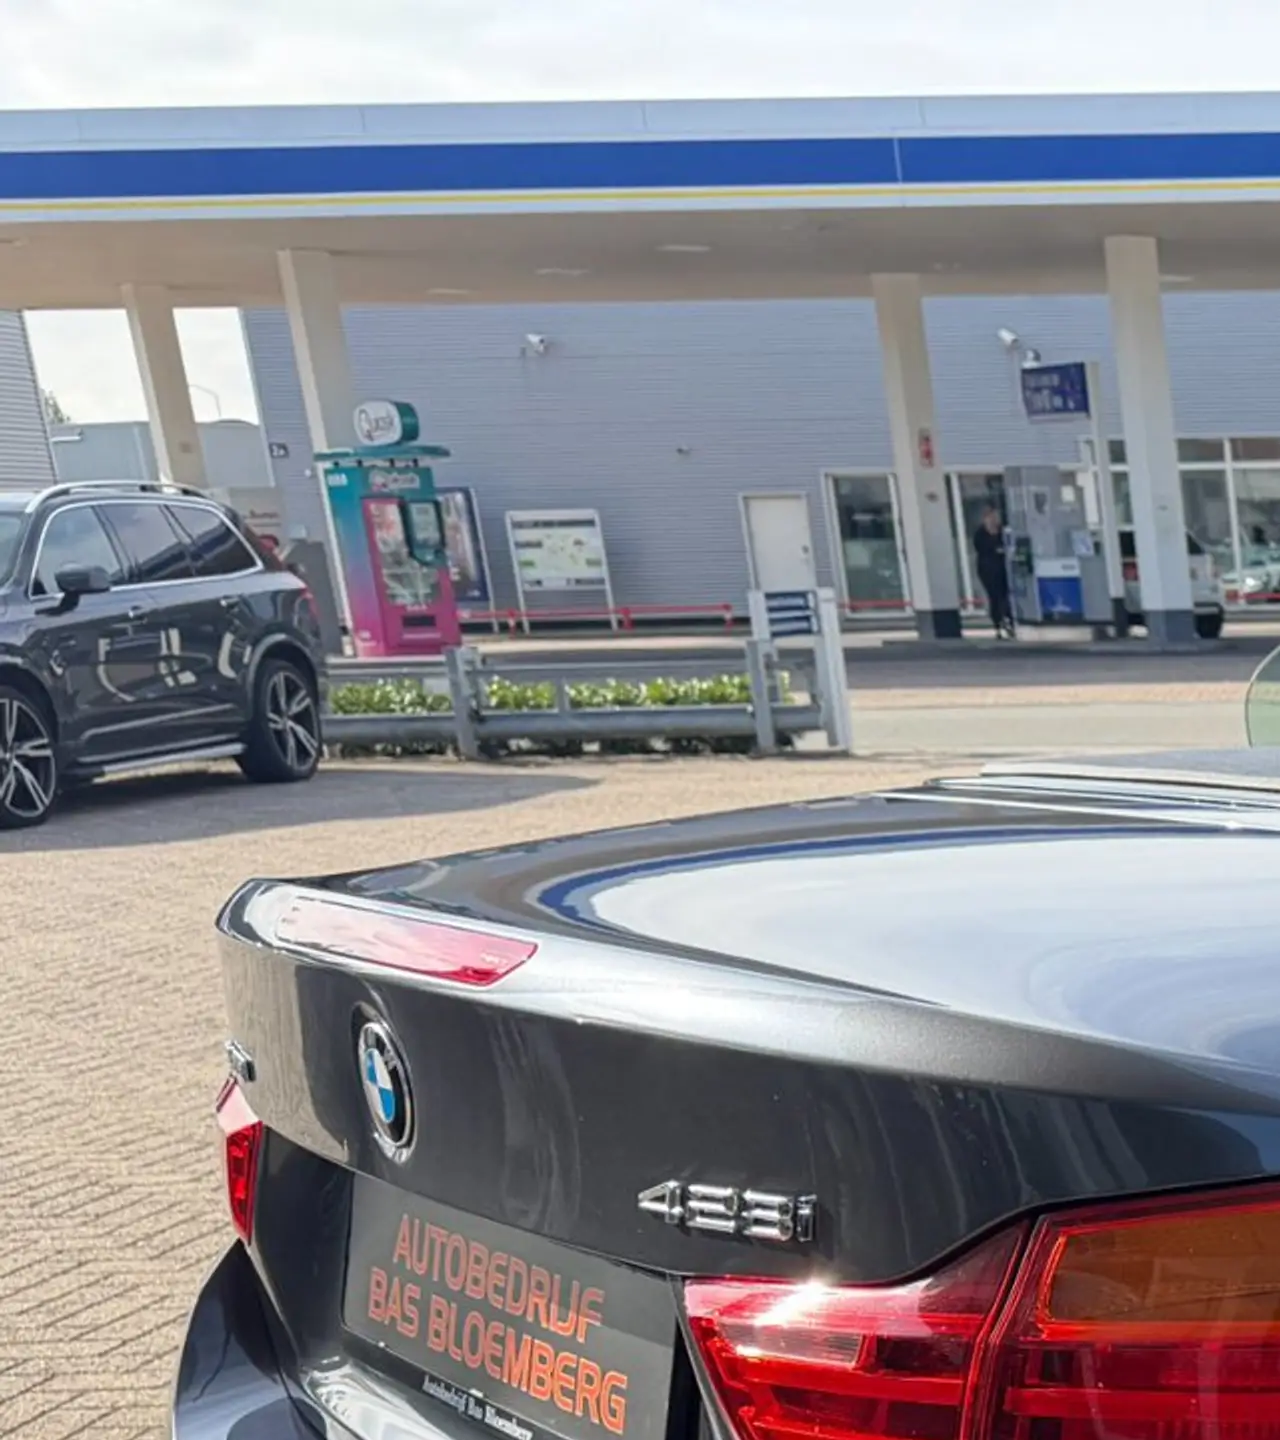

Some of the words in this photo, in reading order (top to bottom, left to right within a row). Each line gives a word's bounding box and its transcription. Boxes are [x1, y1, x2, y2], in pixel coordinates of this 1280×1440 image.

[392, 1212, 606, 1344] AUTOBEDRIJF
[367, 1265, 421, 1339] BAS
[426, 1293, 629, 1435] BLOEMBERG
[467, 1396, 484, 1420] Bas
